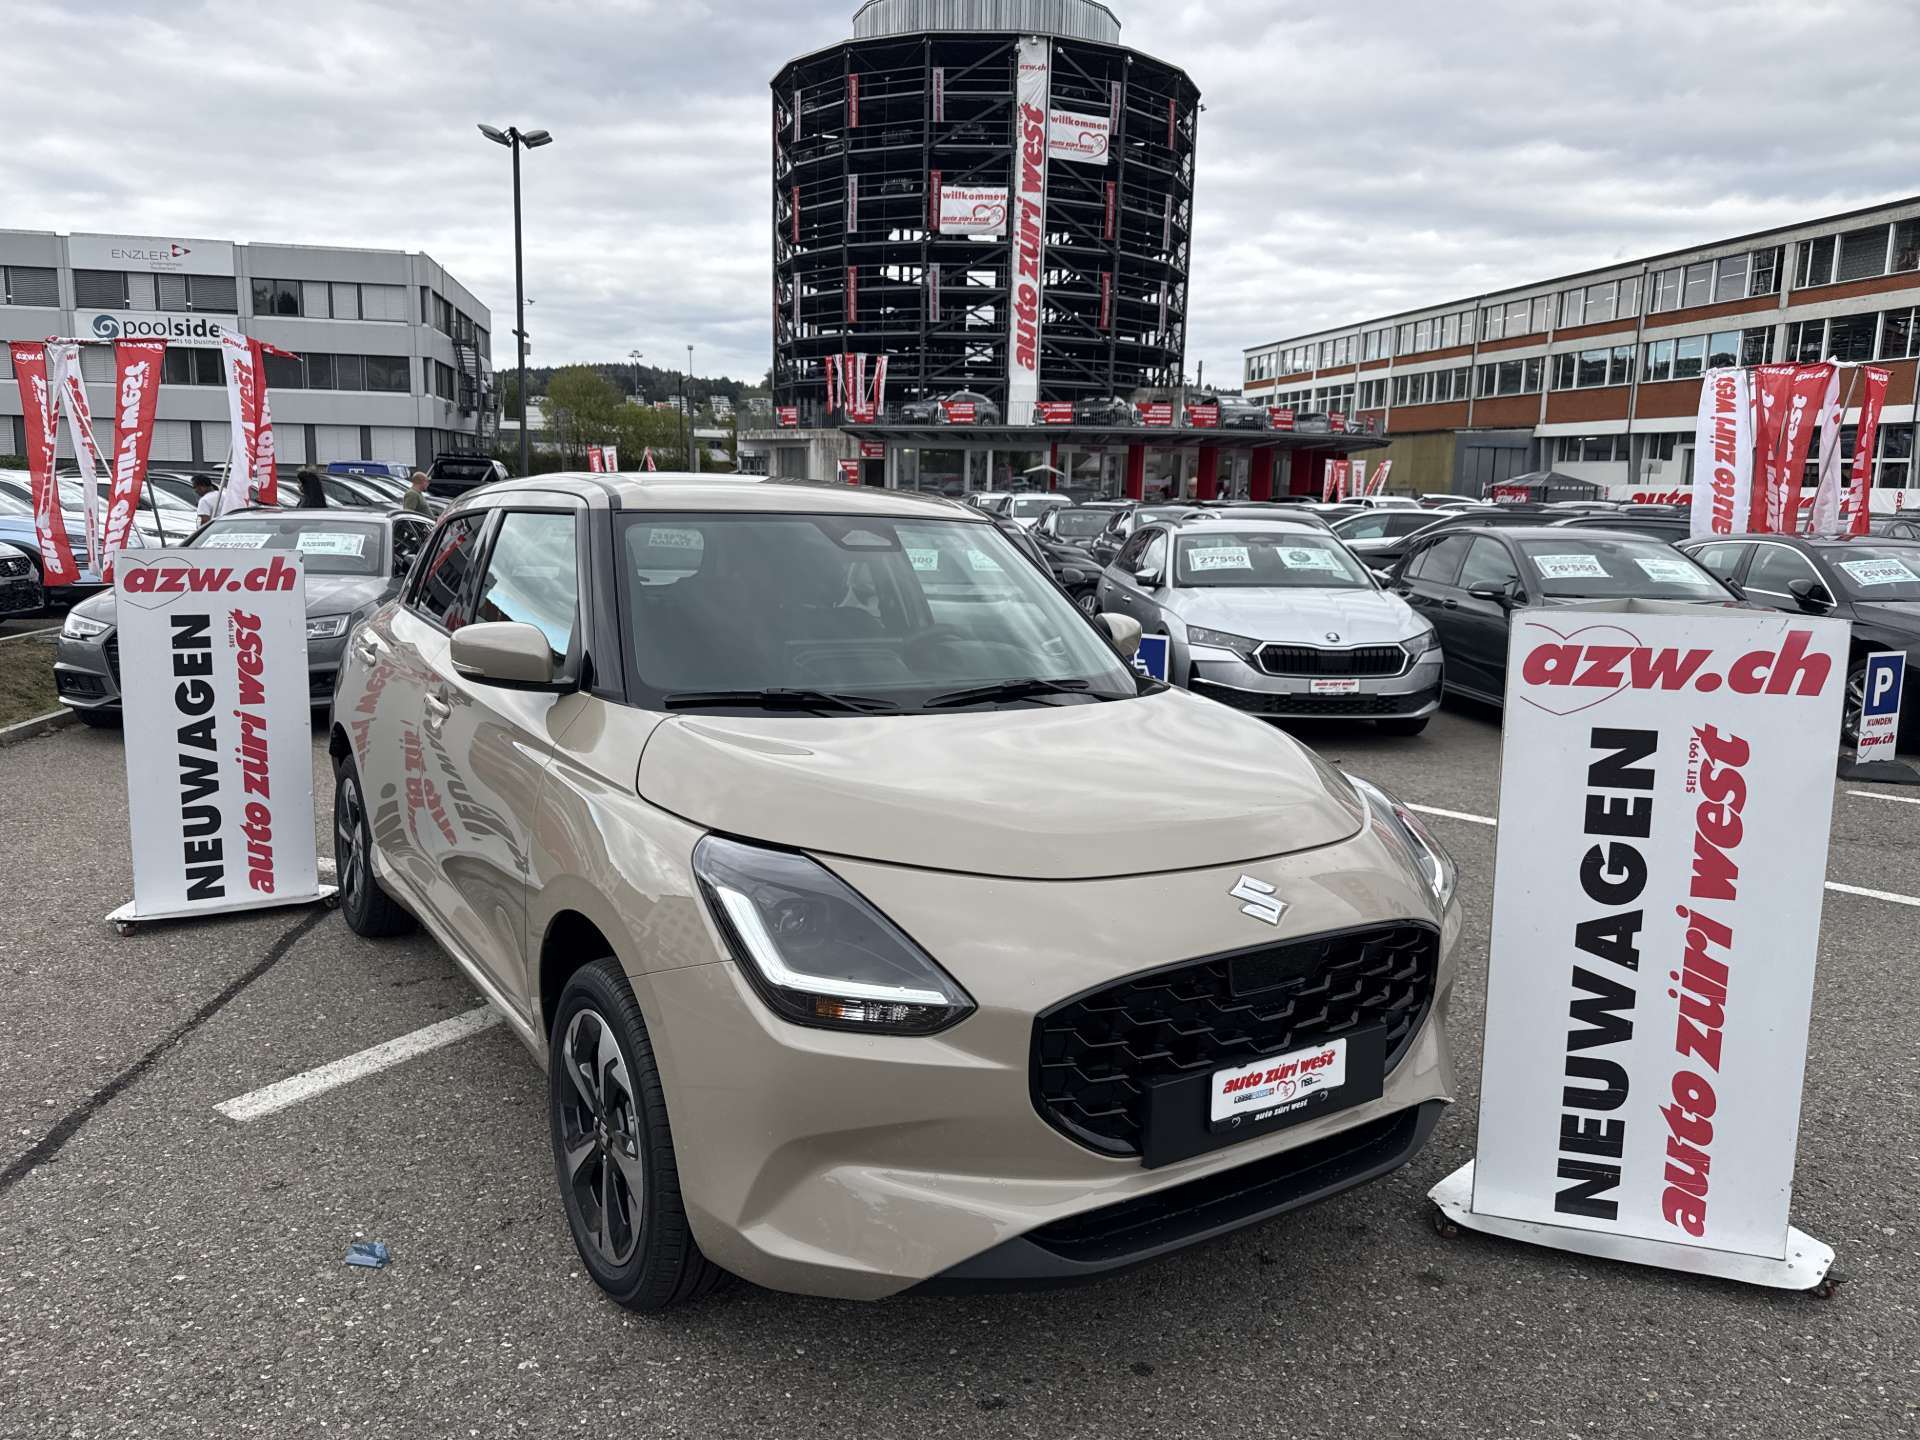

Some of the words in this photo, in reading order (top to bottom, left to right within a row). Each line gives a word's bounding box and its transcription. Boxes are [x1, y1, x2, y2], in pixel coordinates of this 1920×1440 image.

[1020, 102, 1044, 193] west
[1051, 115, 1108, 130] willkommen
[942, 190, 1006, 200] willkommen
[112, 249, 169, 261] ENZLER
[1014, 196, 1041, 282] züri
[123, 317, 221, 339] poolside
[1013, 283, 1038, 371] auto
[1710, 415, 1737, 467] züri
[1711, 467, 1736, 535] auto
[123, 556, 297, 593] azw.ch
[1199, 555, 1245, 564] 27'550
[229, 607, 265, 706] west
[1522, 630, 1833, 698] azw.ch
[1873, 667, 1893, 707] P
[1860, 731, 1895, 747] azw.ch
[1866, 716, 1893, 727] KUNDEN
[170, 613, 226, 901] NEUWAGEN
[233, 709, 270, 801] züri
[1688, 737, 1700, 764] 1991
[1685, 769, 1697, 794] SEIT
[1689, 722, 1750, 901] west
[239, 801, 275, 895] auto
[1553, 726, 1660, 1221] NEUWAGEN
[1669, 904, 1735, 1075] züri
[1223, 1070, 1264, 1094] auto
[1264, 1059, 1300, 1084] züri
[1300, 1048, 1336, 1074] west
[1254, 1109, 1273, 1121] auto
[1661, 1070, 1719, 1238] auto
